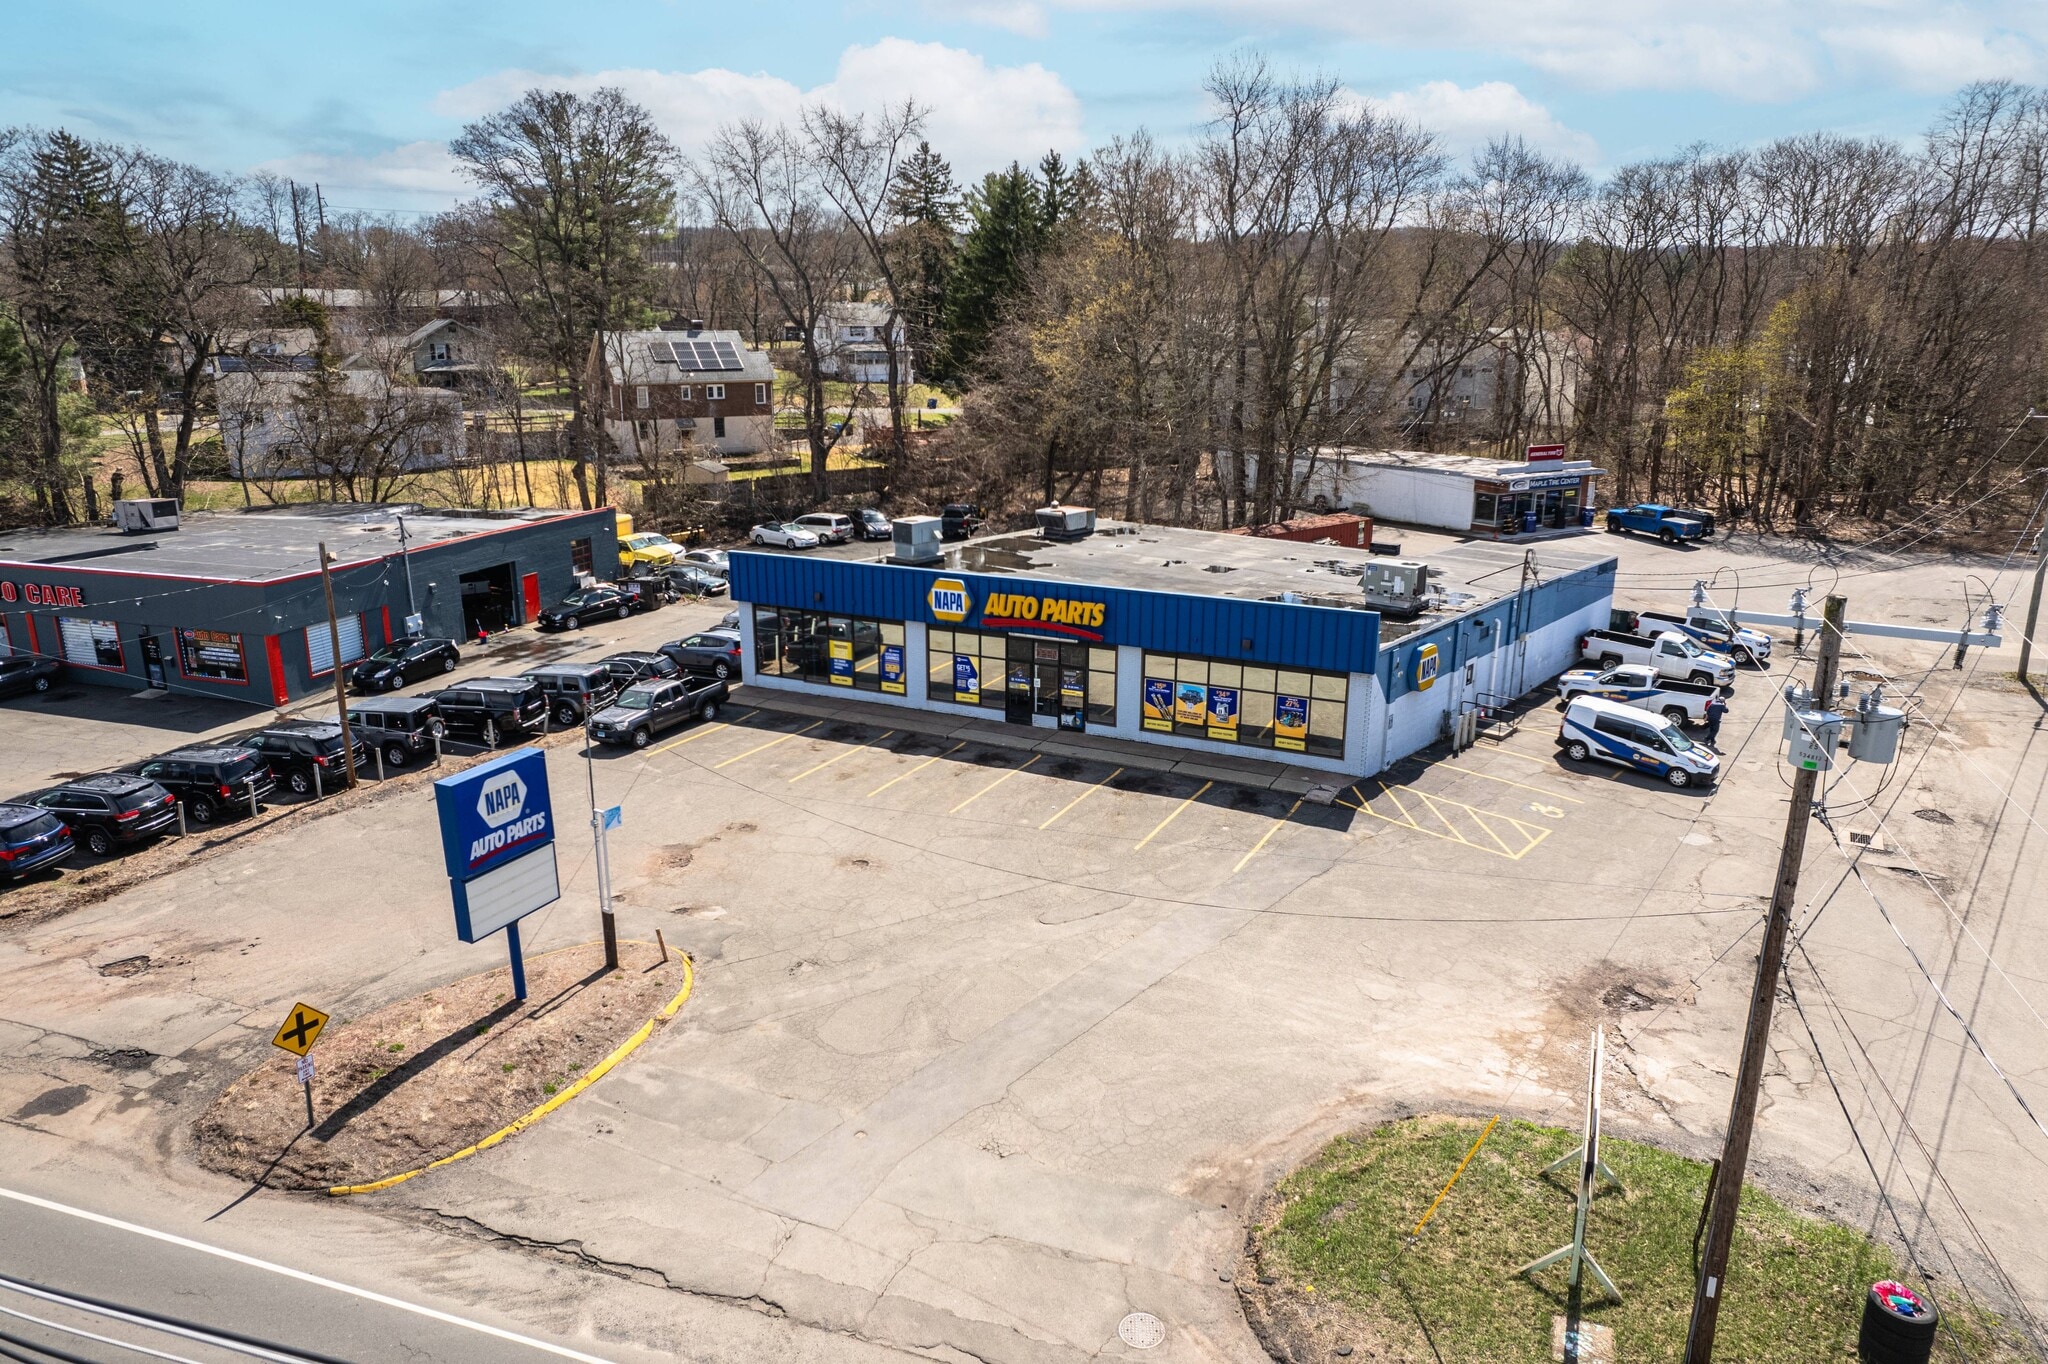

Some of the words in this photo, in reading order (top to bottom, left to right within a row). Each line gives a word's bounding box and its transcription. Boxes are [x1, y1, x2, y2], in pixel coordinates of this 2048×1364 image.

[25, 583, 83, 607] CARE
[934, 590, 964, 612] NAPA
[984, 592, 1039, 620] AUTO
[1041, 598, 1106, 627] PARTS
[1421, 655, 1437, 681] NAPA
[484, 782, 521, 816] NAPA
[469, 829, 505, 861] AUTO
[506, 811, 546, 844] PARTS
